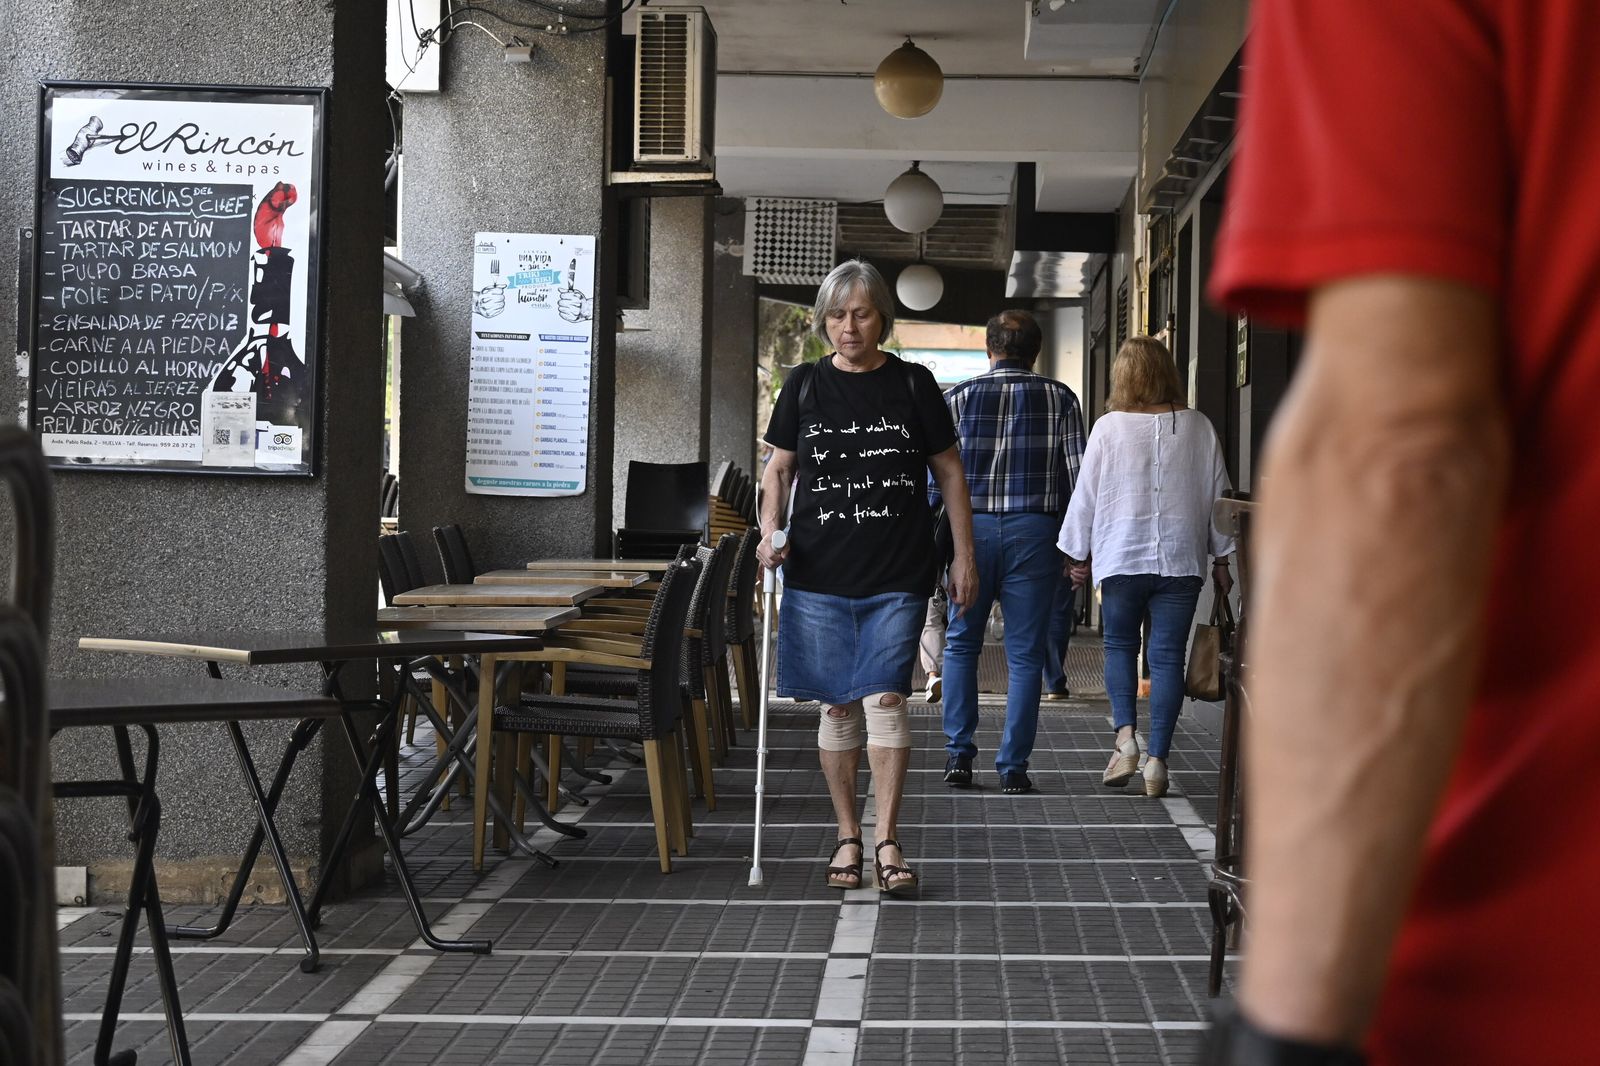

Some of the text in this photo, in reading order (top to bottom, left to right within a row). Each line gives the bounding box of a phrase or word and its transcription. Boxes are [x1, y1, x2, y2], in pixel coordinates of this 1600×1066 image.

[114, 121, 304, 156] El Rincón
[142, 159, 281, 177] wines & tapas
[193, 186, 214, 196] DEL
[200, 196, 250, 214] CHEF
[56, 219, 132, 240] TARTAR
[137, 222, 159, 239] DE
[59, 240, 242, 260] TARTAR DE SALMON
[62, 263, 197, 282] PULPO BRASA
[60, 282, 110, 309] FOIE
[120, 284, 145, 300] DE
[52, 313, 140, 332] ENSALADA
[143, 314, 166, 331] DE
[50, 335, 232, 356] CARNE A LA PIEDRA
[50, 356, 224, 380] CODILLO AL HORNO
[44, 378, 199, 400] VIEIRAS AL JEREZ
[52, 401, 122, 416] ARROZ
[125, 400, 195, 419] NEGRO
[42, 416, 77, 434] REV.
[82, 418, 102, 434] DE
[805, 416, 910, 438] I'm not waiting
[811, 446, 830, 465] for
[811, 472, 916, 498] I'm just waiting
[817, 506, 834, 525] for
